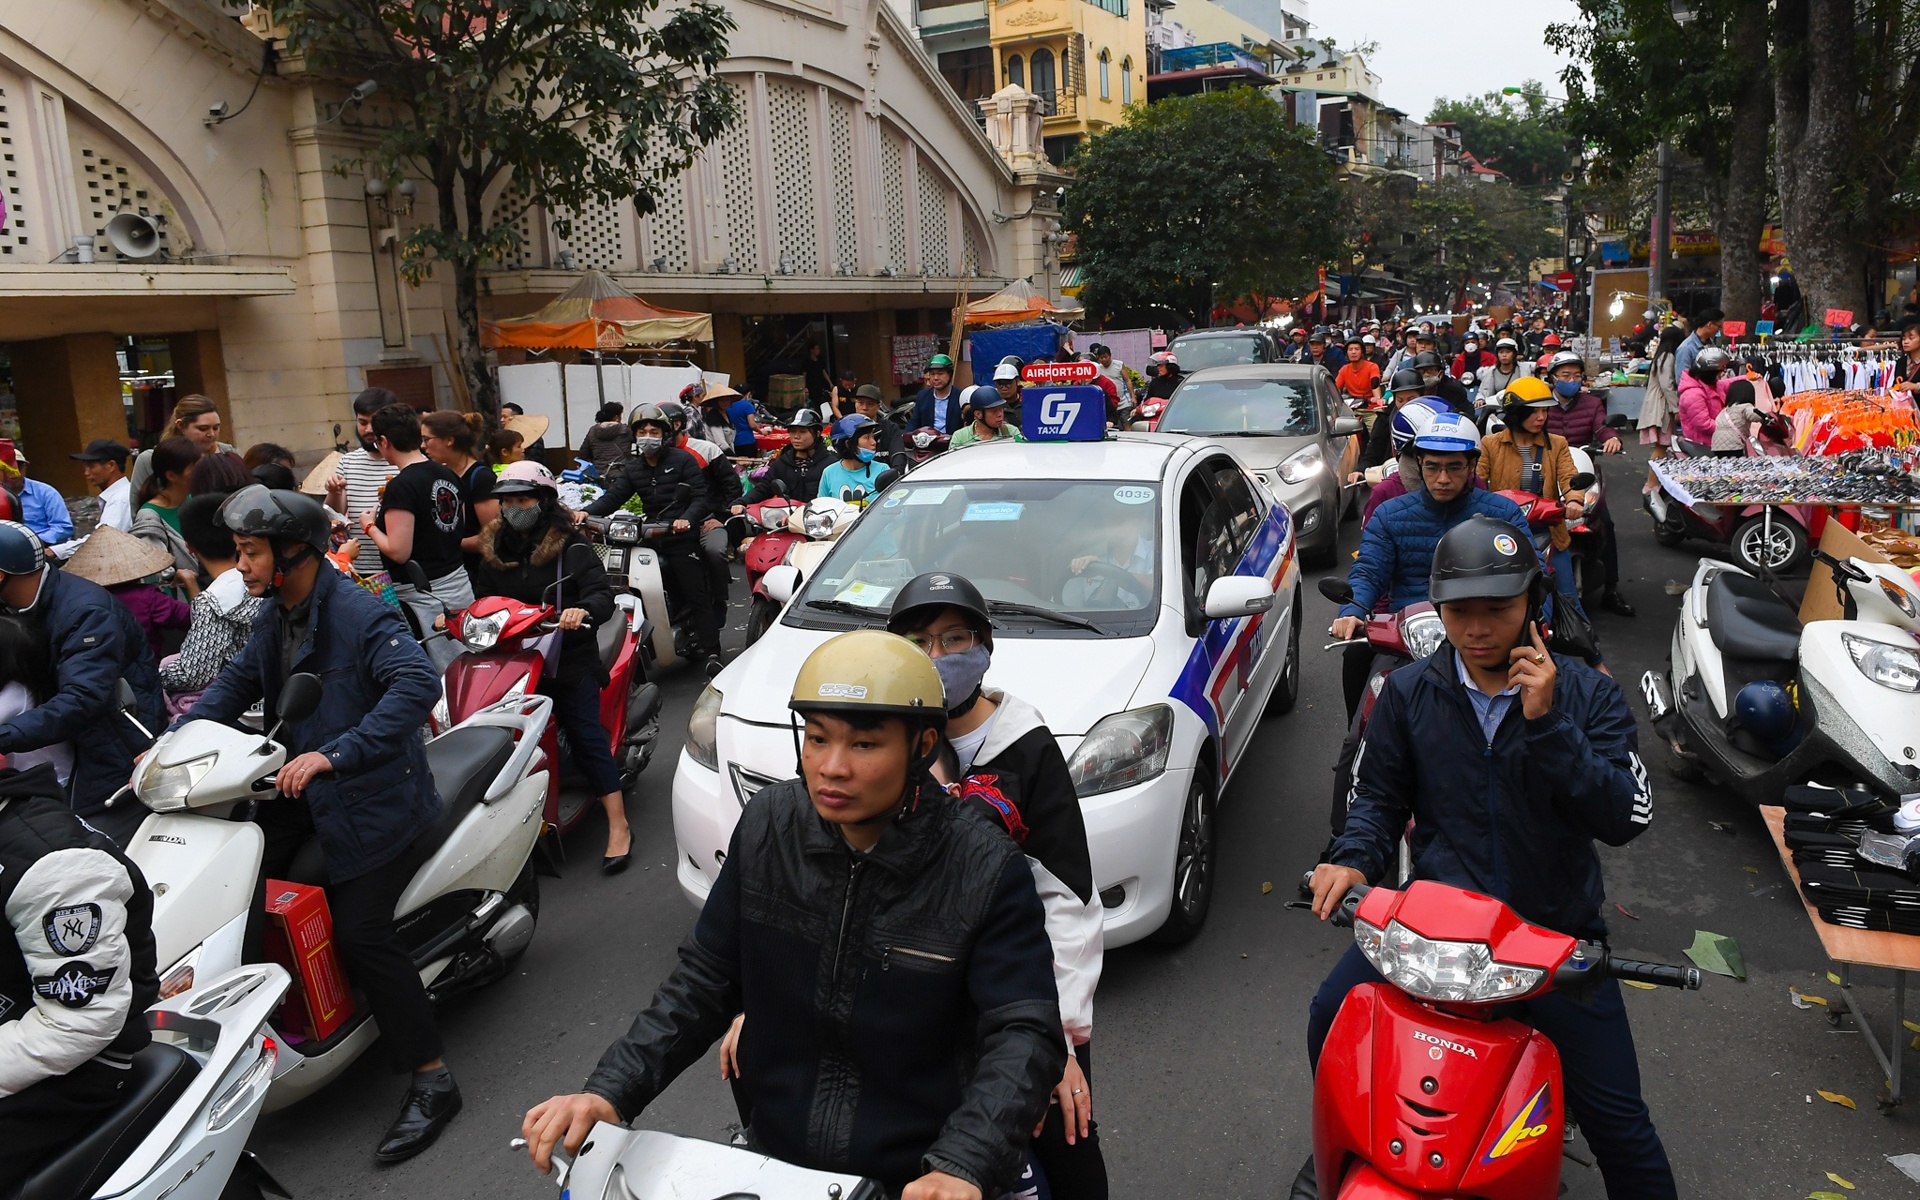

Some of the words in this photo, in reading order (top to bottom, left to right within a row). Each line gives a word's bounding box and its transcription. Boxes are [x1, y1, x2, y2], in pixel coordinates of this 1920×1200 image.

[1026, 366, 1092, 378] AIRPORT-ĐN
[1040, 393, 1081, 434] G7
[1037, 426, 1060, 434] TAXI
[1116, 490, 1151, 498] 4035
[56, 909, 72, 917] NEW
[72, 905, 91, 914] YORK
[1413, 1030, 1478, 1059] HONDA
